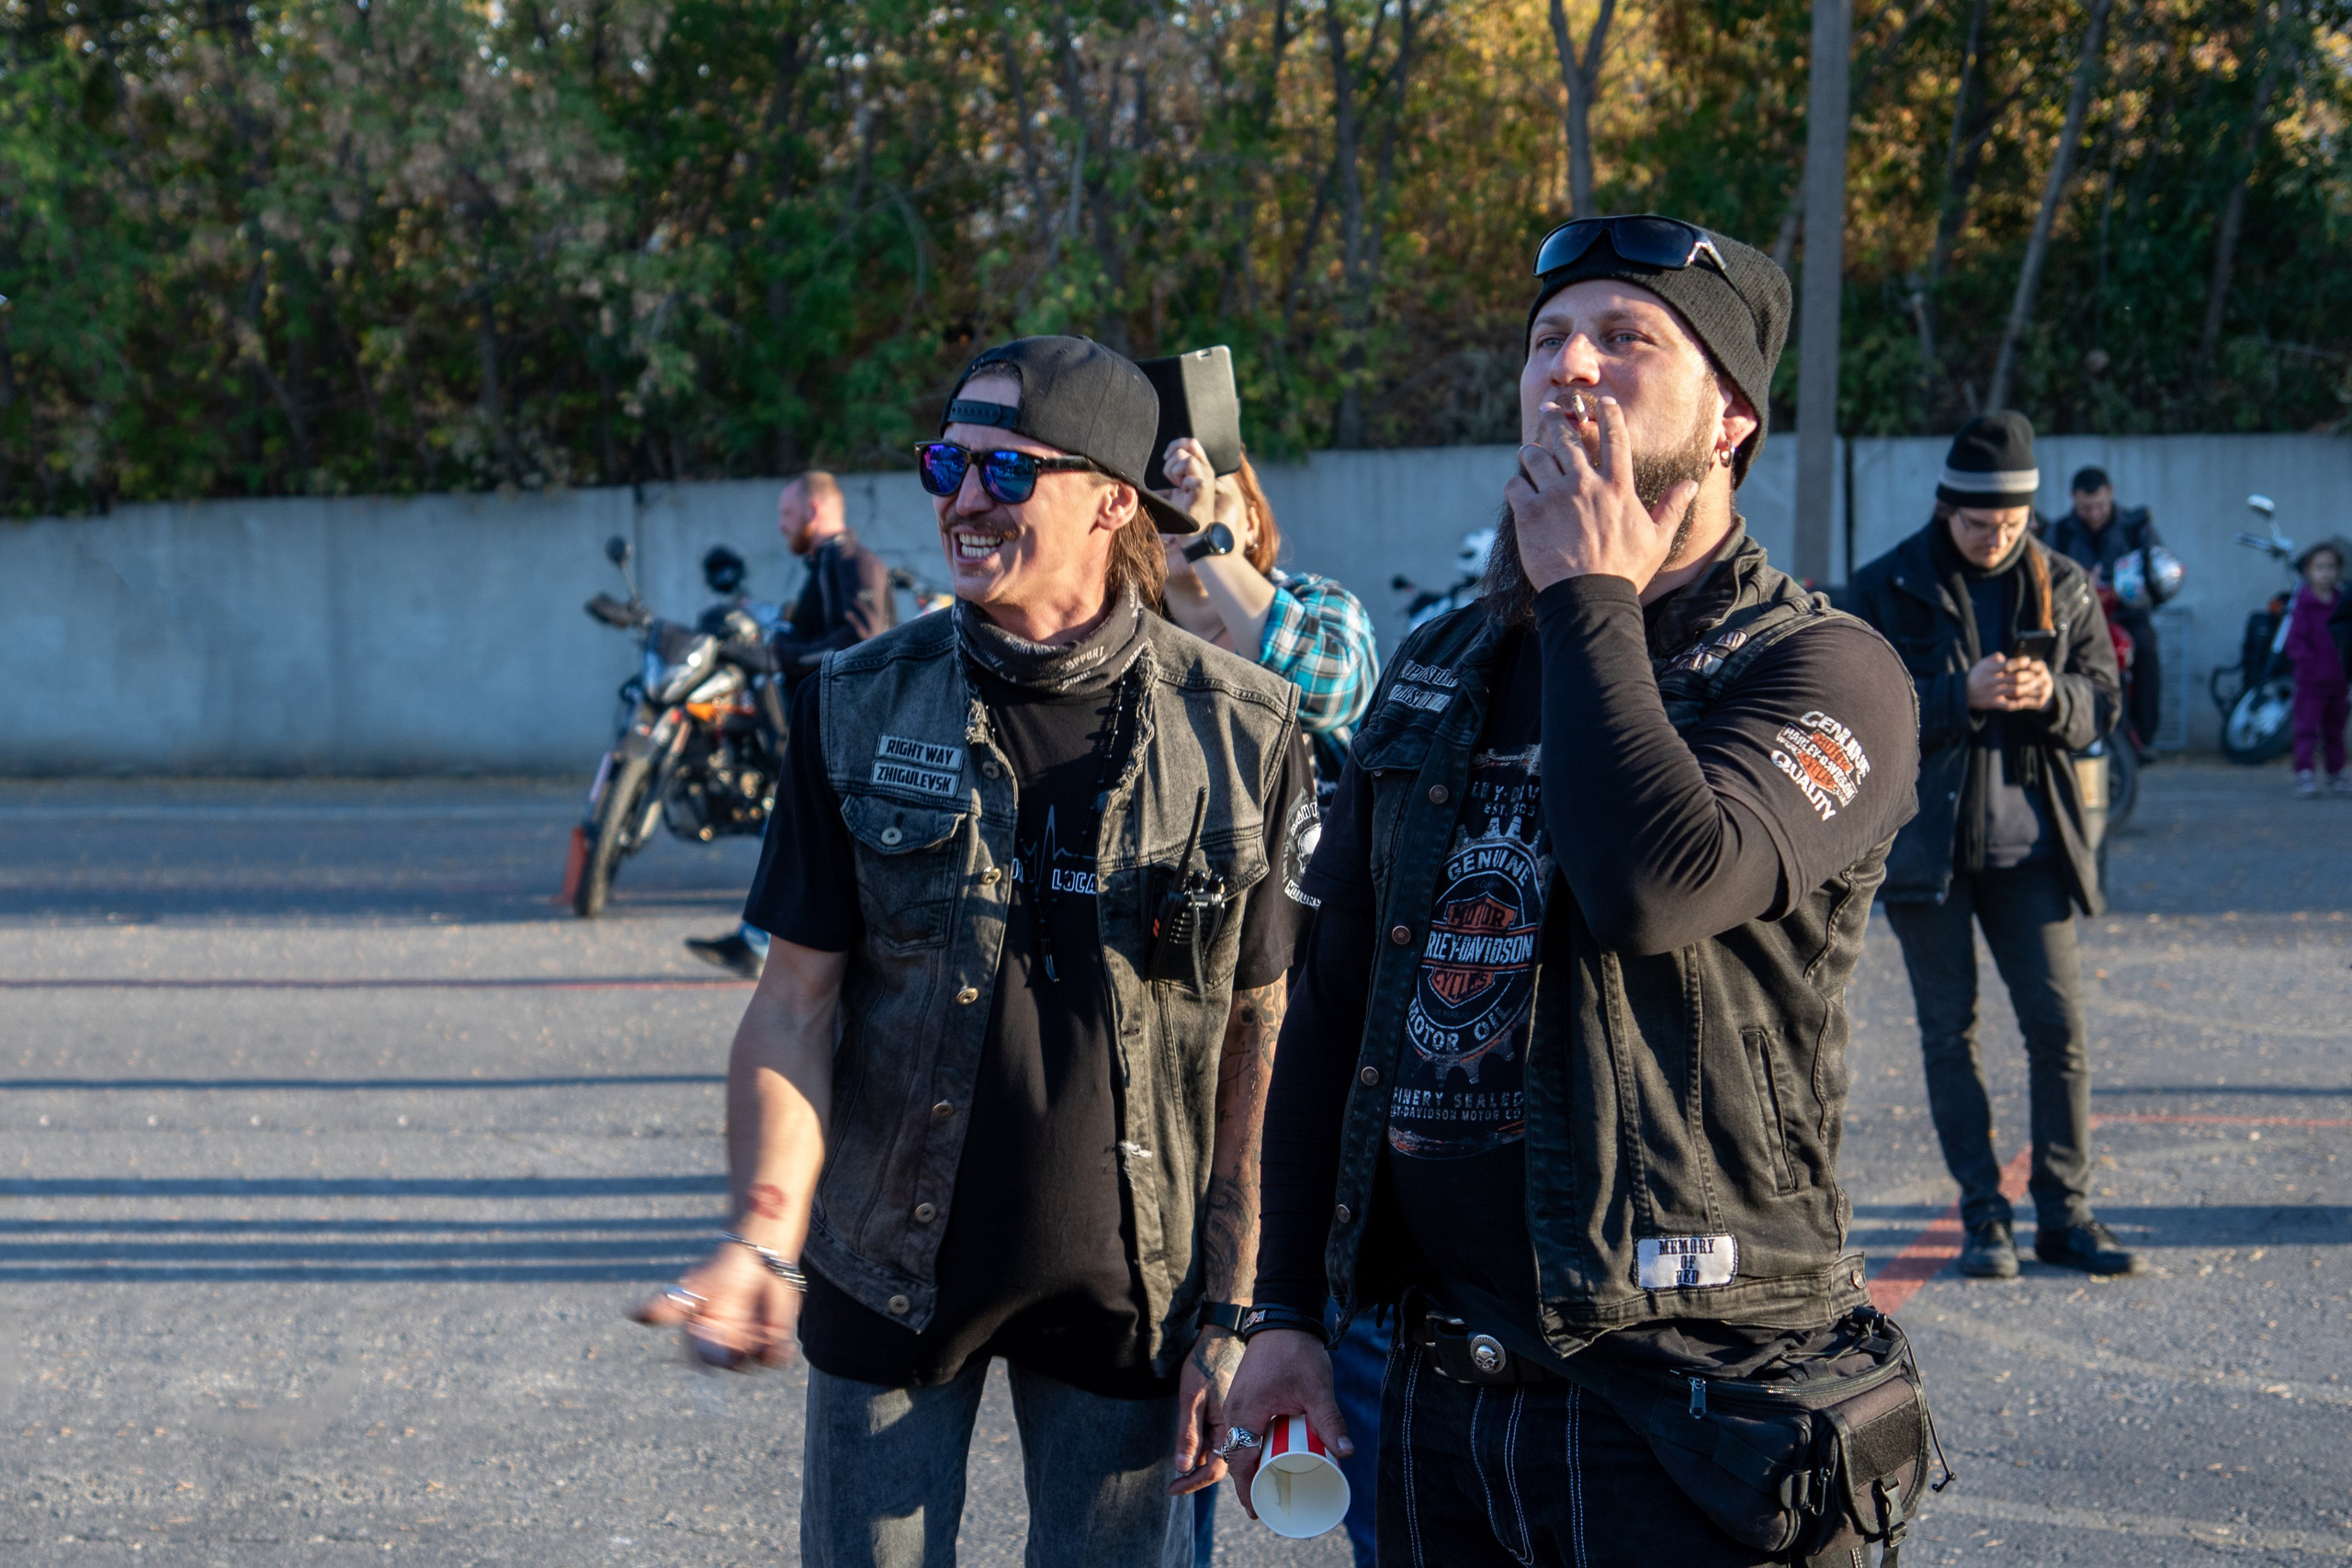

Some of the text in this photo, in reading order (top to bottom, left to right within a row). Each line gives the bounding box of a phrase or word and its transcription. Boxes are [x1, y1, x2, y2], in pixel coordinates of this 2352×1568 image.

[886, 739, 955, 765] RIGHT WAY
[876, 765, 953, 793] ZHIGULEVSK
[1770, 750, 1837, 821] QUALITY
[1447, 845, 1532, 887] GENUINE
[1450, 901, 1506, 928] MOTOR
[1434, 967, 1489, 1000] CYCLES
[1408, 996, 1513, 1053] MOTOR OIL
[1461, 1109, 1499, 1121] MOTOR
[1658, 1238, 1716, 1256] MEMORY
[1680, 1255, 1696, 1269] OF
